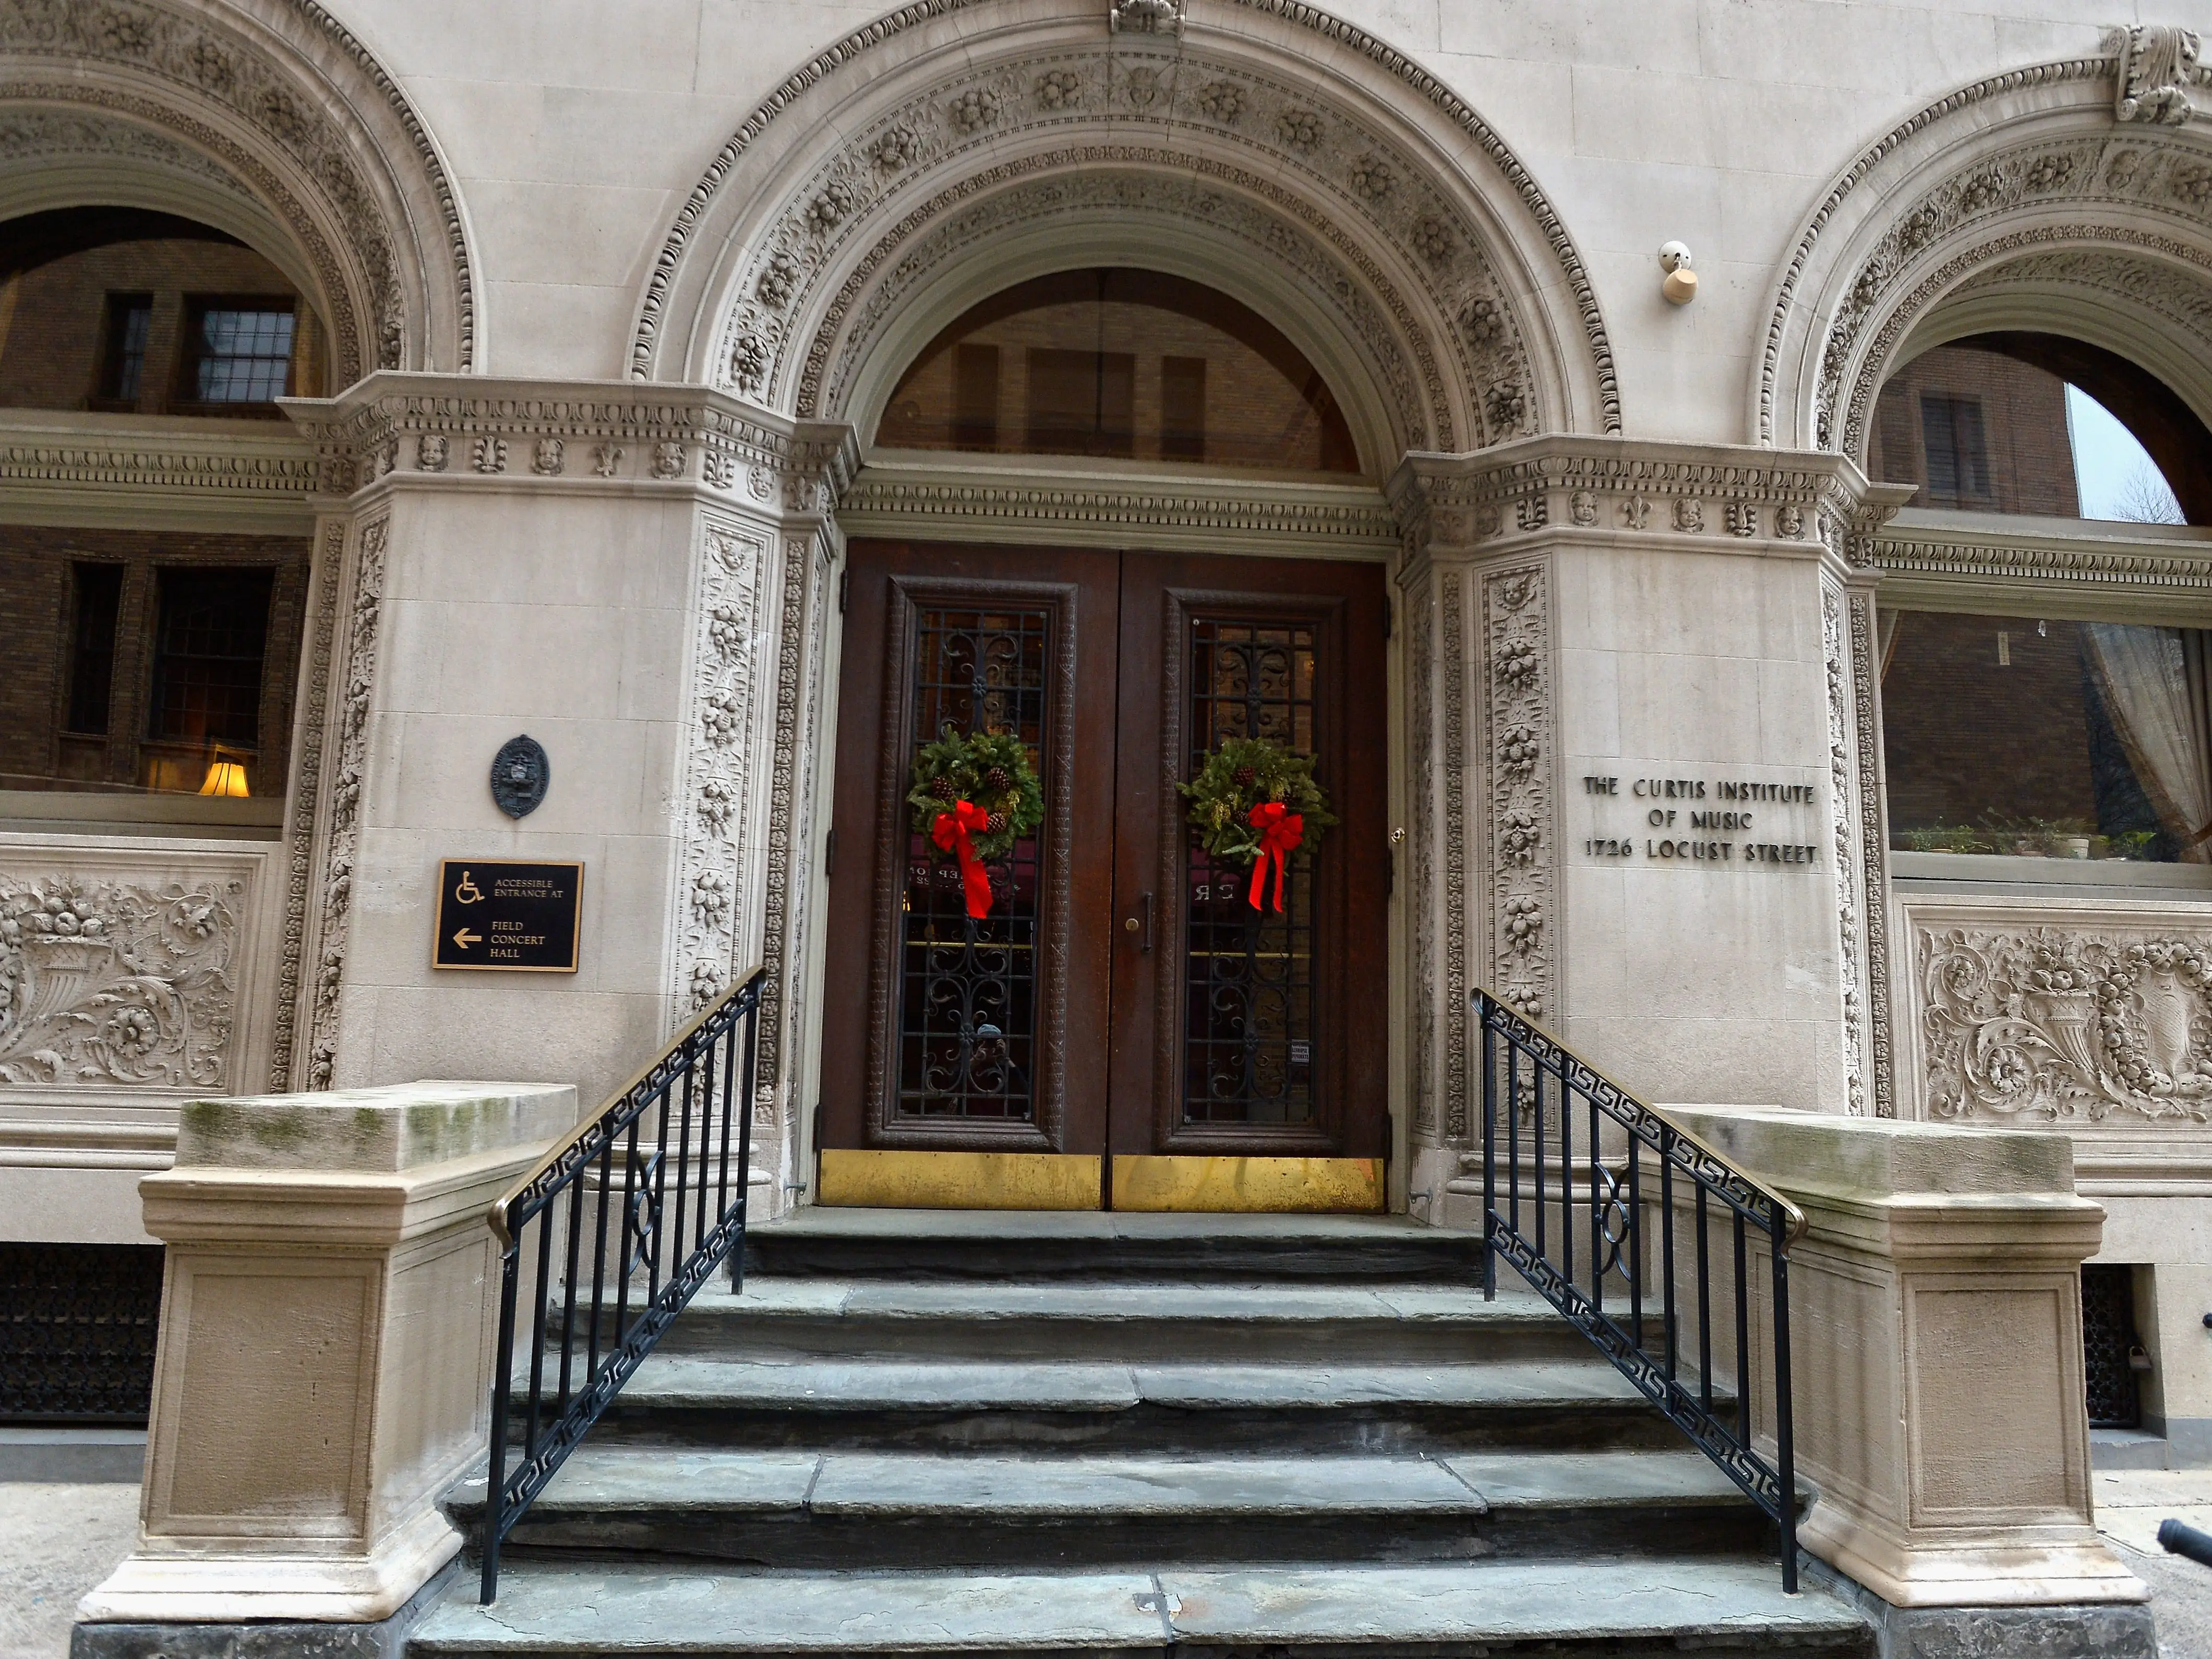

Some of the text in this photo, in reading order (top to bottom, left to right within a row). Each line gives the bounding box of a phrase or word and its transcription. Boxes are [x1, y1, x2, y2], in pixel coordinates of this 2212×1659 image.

[1583, 776, 1814, 803] THE CURTIS INSTITUTE
[1649, 809, 1752, 829] OF MUSIC
[1586, 838, 1817, 863] 1726 LOCUST STREET
[495, 879, 553, 888] ACCESSIBLE
[494, 889, 547, 898] ENTRANCE
[492, 921, 523, 930] FIELD
[491, 935, 546, 945] CONCERT
[490, 948, 521, 958] HALL
